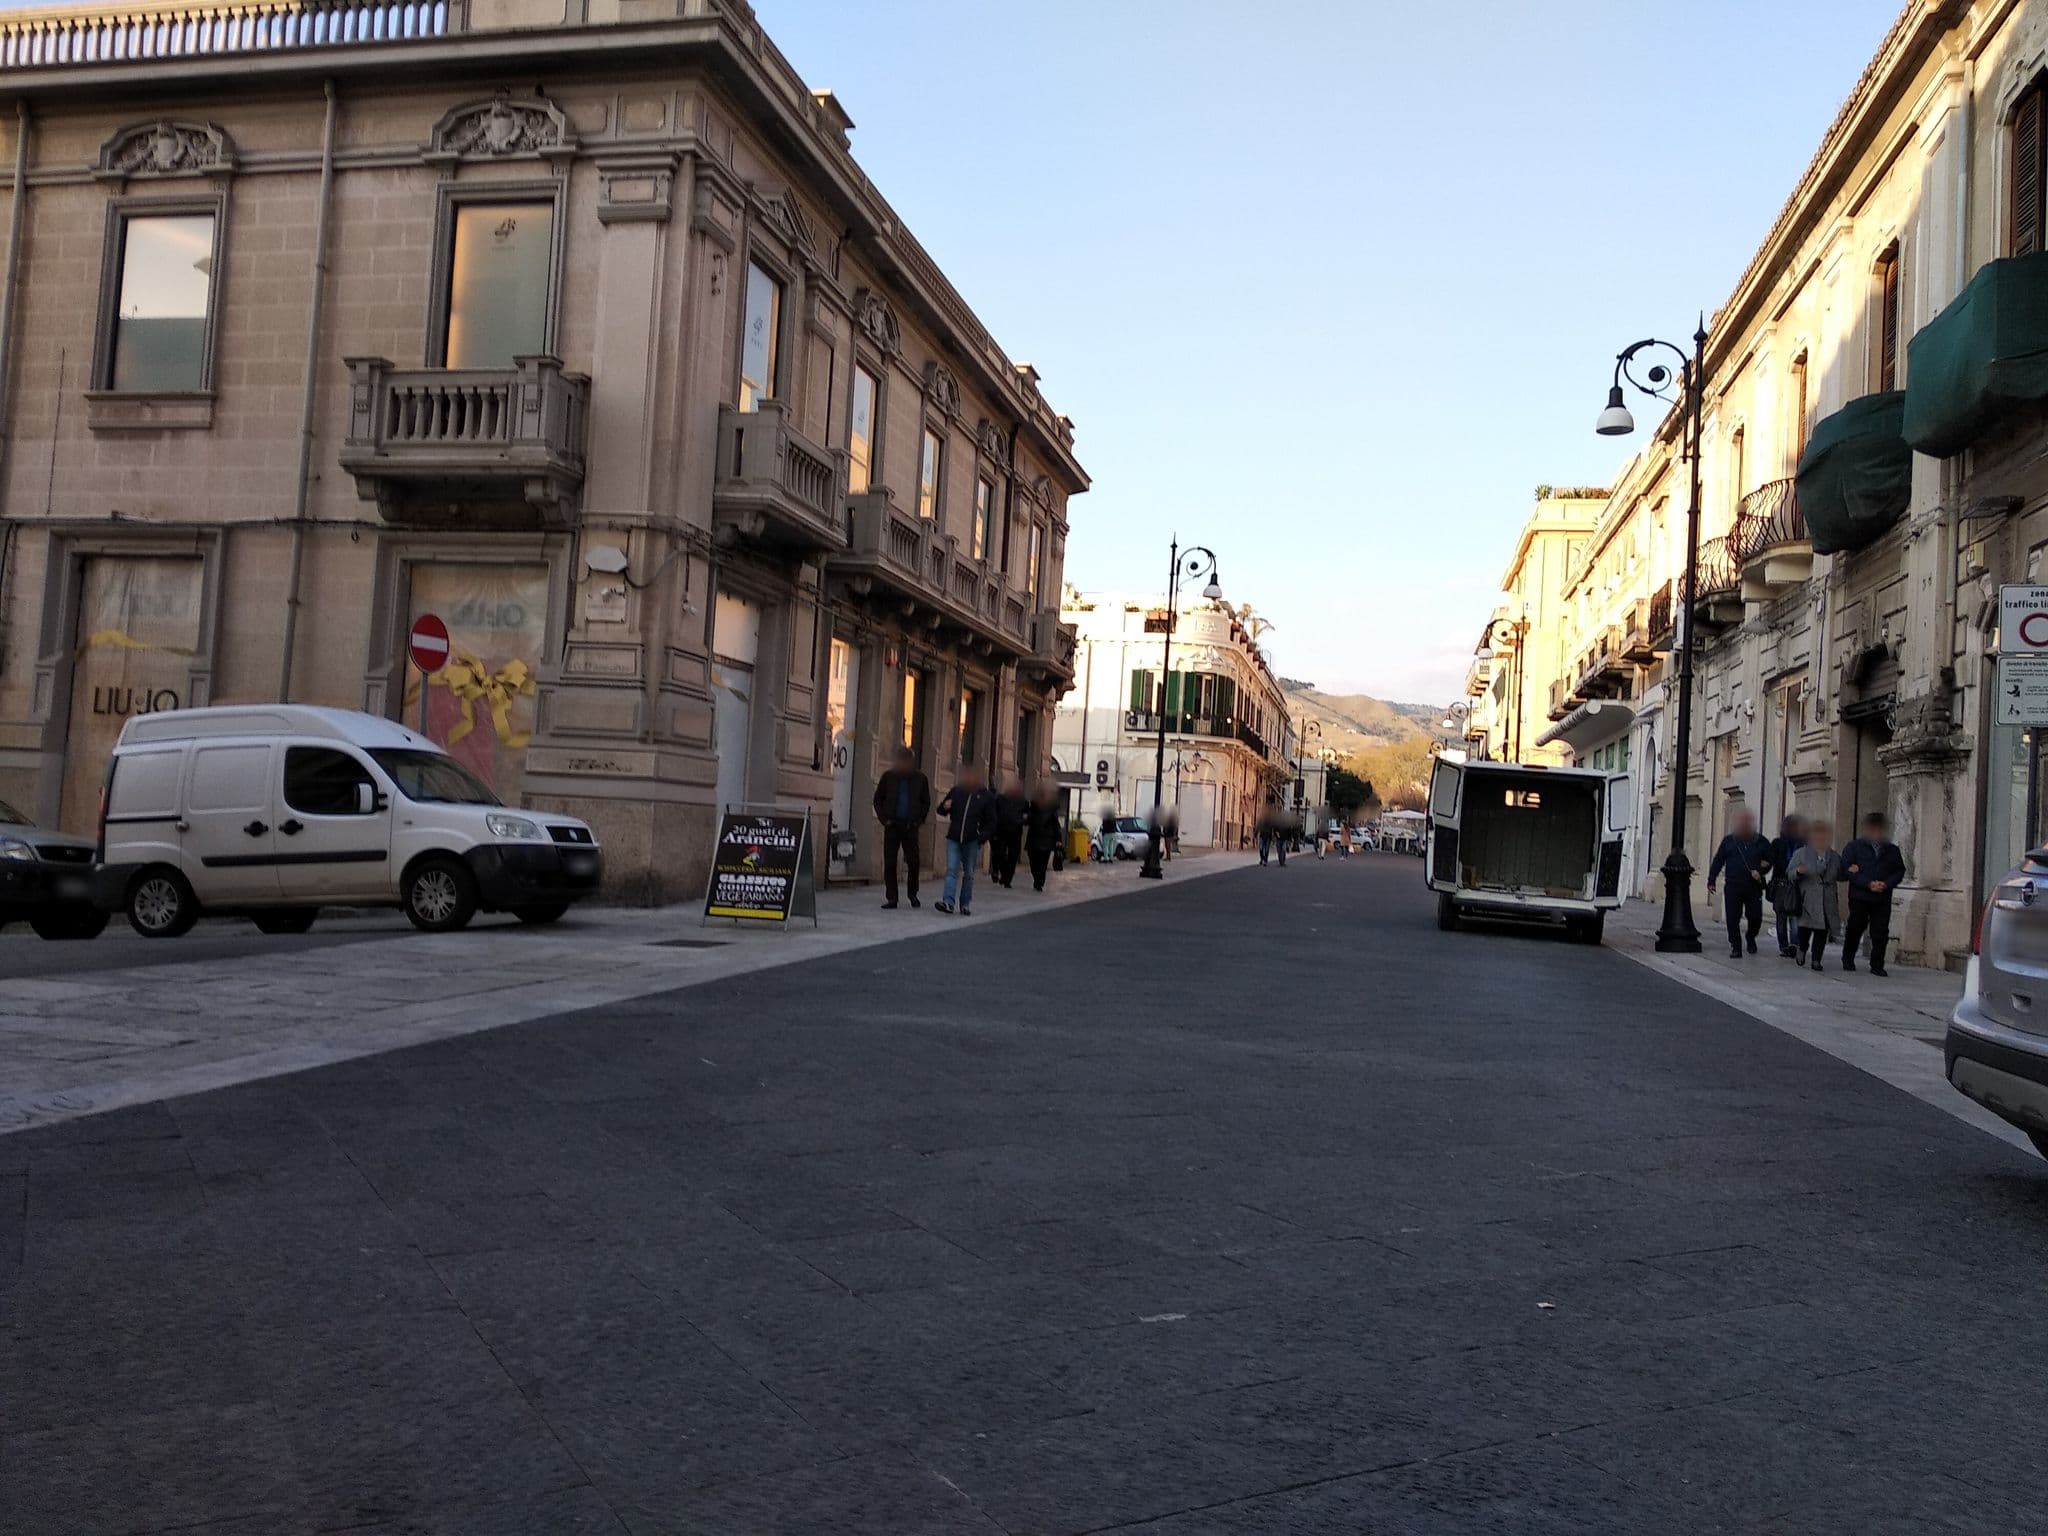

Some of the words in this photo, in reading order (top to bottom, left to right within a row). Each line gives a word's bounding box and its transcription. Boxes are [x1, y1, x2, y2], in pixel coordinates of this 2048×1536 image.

[2005, 600, 2038, 608] traffico
[732, 825, 747, 834] 20
[749, 827, 775, 837] gusti
[778, 826, 789, 836] di
[722, 832, 796, 847] Arancini
[715, 889, 785, 902] VEGETARIANO
